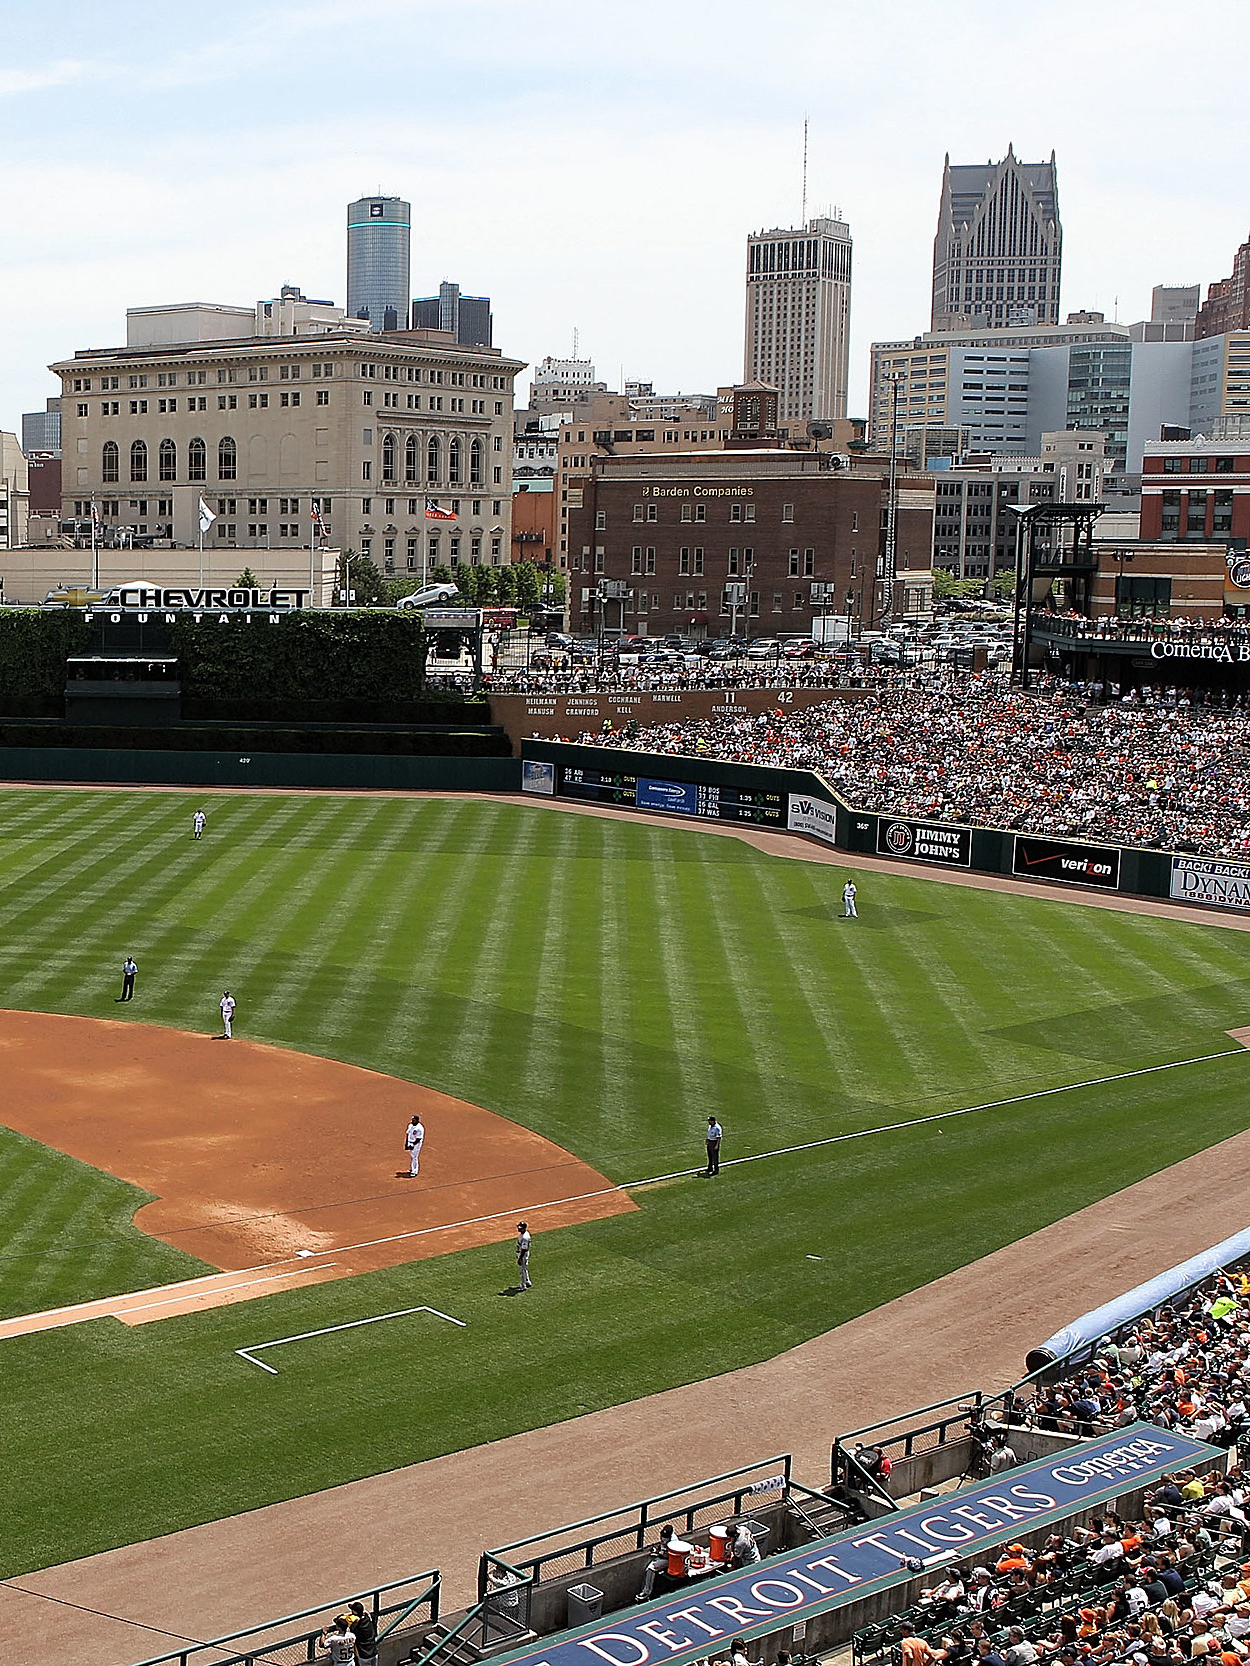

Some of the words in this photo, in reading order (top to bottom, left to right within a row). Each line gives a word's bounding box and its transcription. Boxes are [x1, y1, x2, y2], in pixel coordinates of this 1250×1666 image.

[652, 486, 690, 497] Barden
[693, 485, 754, 498] Companies
[119, 588, 314, 609] CHEVROLET
[84, 613, 280, 624] FOUNTAIN
[724, 692, 736, 704] 11
[778, 691, 794, 704] 42
[814, 808, 834, 824] VISION
[915, 828, 961, 844] JIMMY
[914, 843, 960, 859] JOHN'S
[1061, 857, 1112, 877] verizon
[1178, 860, 1212, 872] BACK!
[1214, 865, 1249, 878] BACK!
[1100, 1456, 1157, 1481] PARK
[576, 1555, 865, 1666] DETROIT
[852, 1484, 1057, 1561] TIGERS
